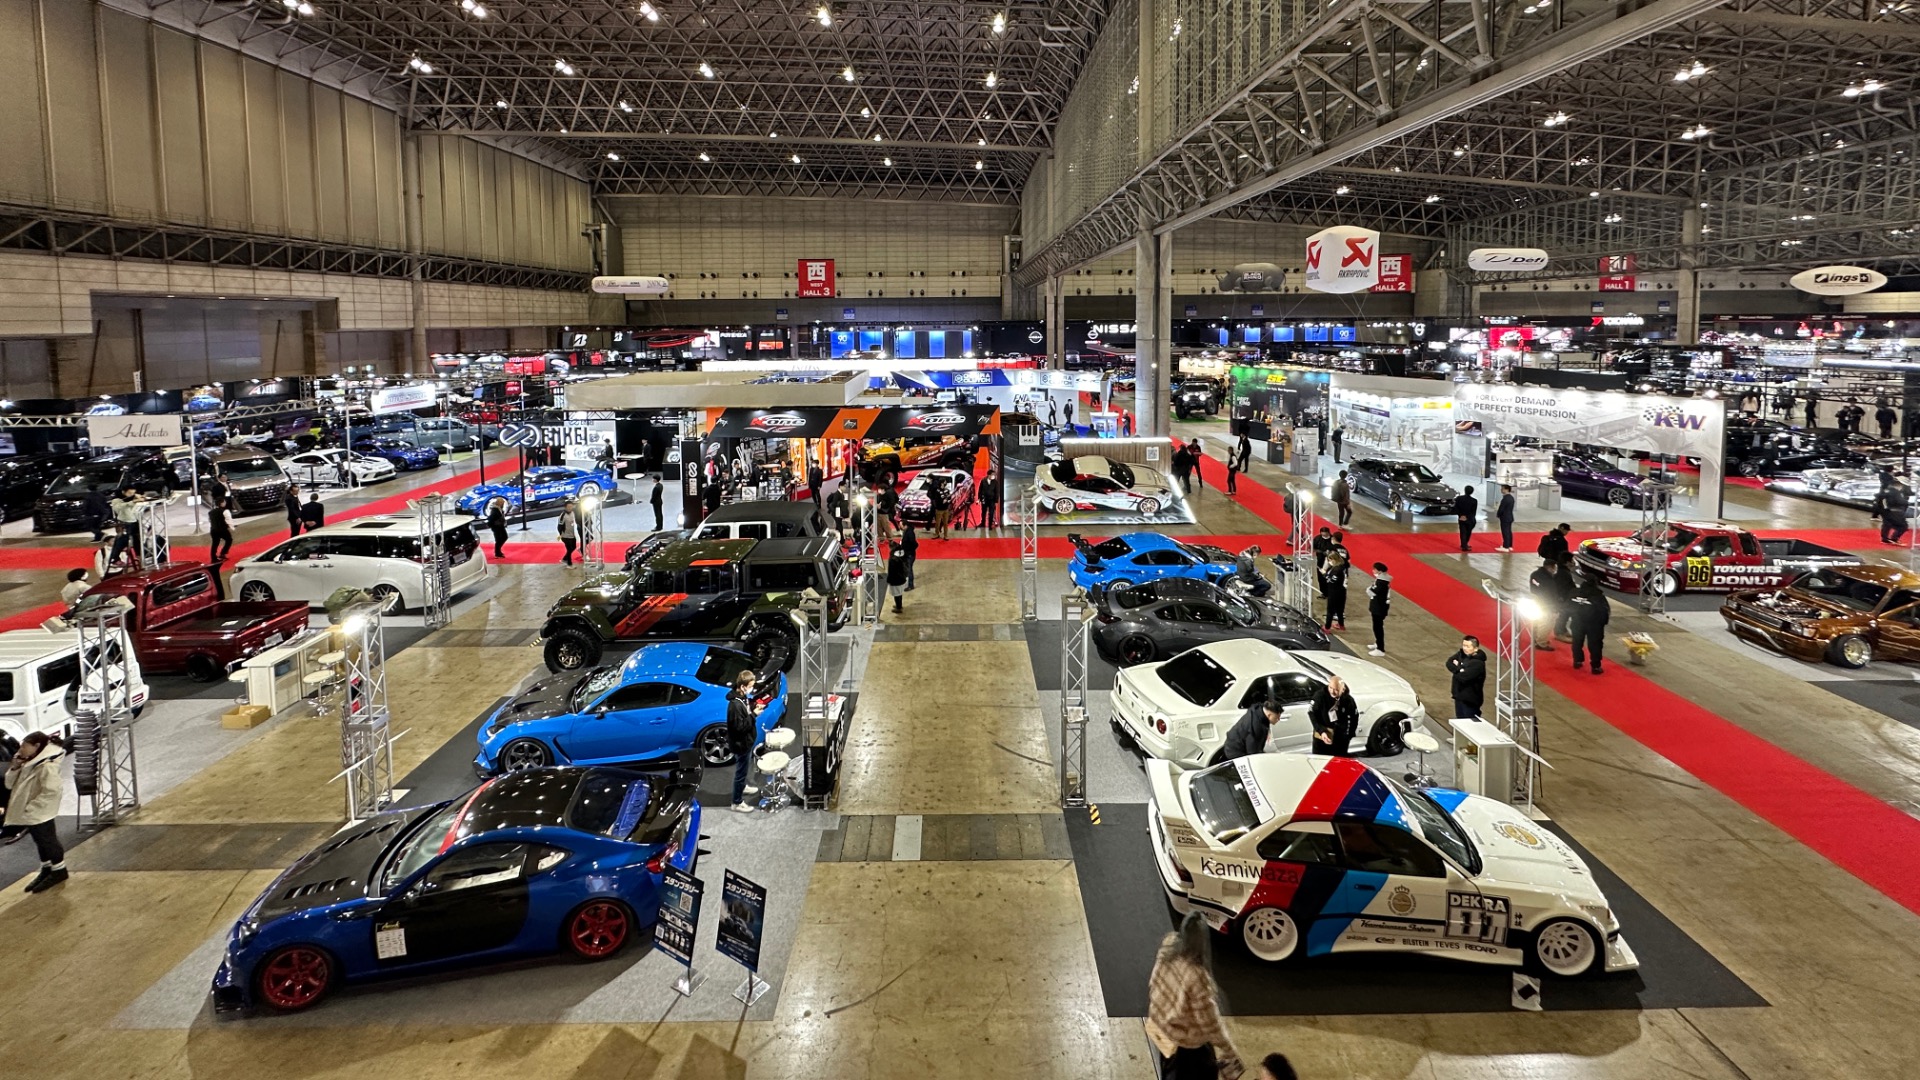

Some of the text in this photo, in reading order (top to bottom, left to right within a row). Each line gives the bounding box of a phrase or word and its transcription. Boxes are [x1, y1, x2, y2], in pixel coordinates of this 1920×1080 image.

[807, 262, 826, 281] 西
[1380, 256, 1402, 276] 西
[823, 287, 830, 296] 3
[1398, 281, 1406, 291] 2
[1624, 280, 1630, 289] 1
[1093, 324, 1137, 333] NISSA
[1515, 396, 1556, 407] DEMAND
[1474, 402, 1512, 413] PERFECT
[1514, 406, 1576, 419] SUSPENSION
[1654, 411, 1707, 431] KW
[1689, 565, 1710, 582] 96
[1713, 565, 1783, 574] TOYO TIRES
[1712, 575, 1783, 585] DONUT
[1238, 764, 1261, 807] BMW M Team
[1200, 856, 1299, 883] Kamiwaza
[1450, 894, 1507, 913] DEKRA
[1402, 938, 1429, 947] BILSTEIN
[1434, 940, 1460, 950] TEVES
[1465, 944, 1498, 955] RECARO
